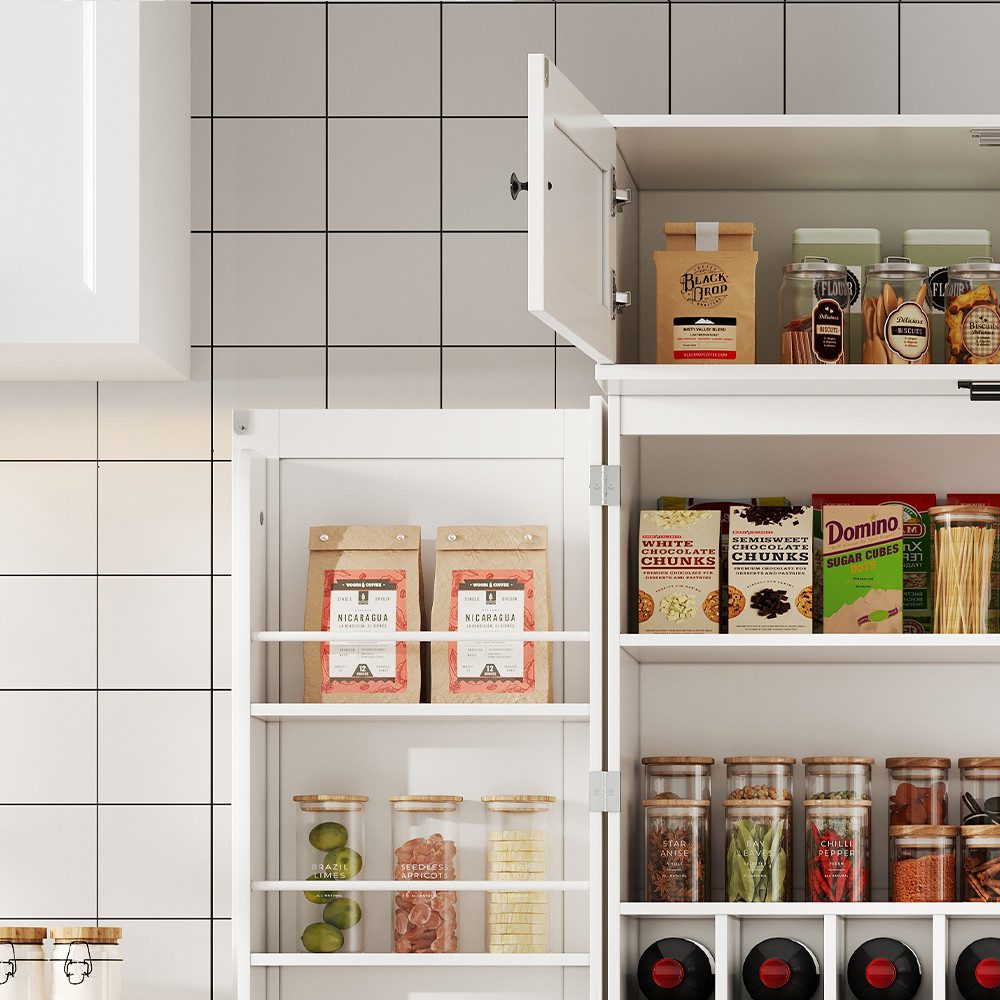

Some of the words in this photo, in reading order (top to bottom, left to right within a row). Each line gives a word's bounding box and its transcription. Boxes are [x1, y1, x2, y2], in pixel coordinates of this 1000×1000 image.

[680, 273, 727, 292] BLACK
[822, 281, 853, 296] FLOUR
[969, 322, 999, 330] Biscuits
[897, 327, 922, 335] BISCUITS
[825, 516, 898, 545] Domino
[731, 552, 808, 561] CHUNKS
[826, 553, 862, 569] SUGAR
[865, 543, 899, 560] CUBES
[641, 556, 716, 566] CHUNKS
[337, 614, 388, 622] NICARAGUA
[465, 614, 516, 622] NICARAGUA
[663, 840, 687, 848] STAR
